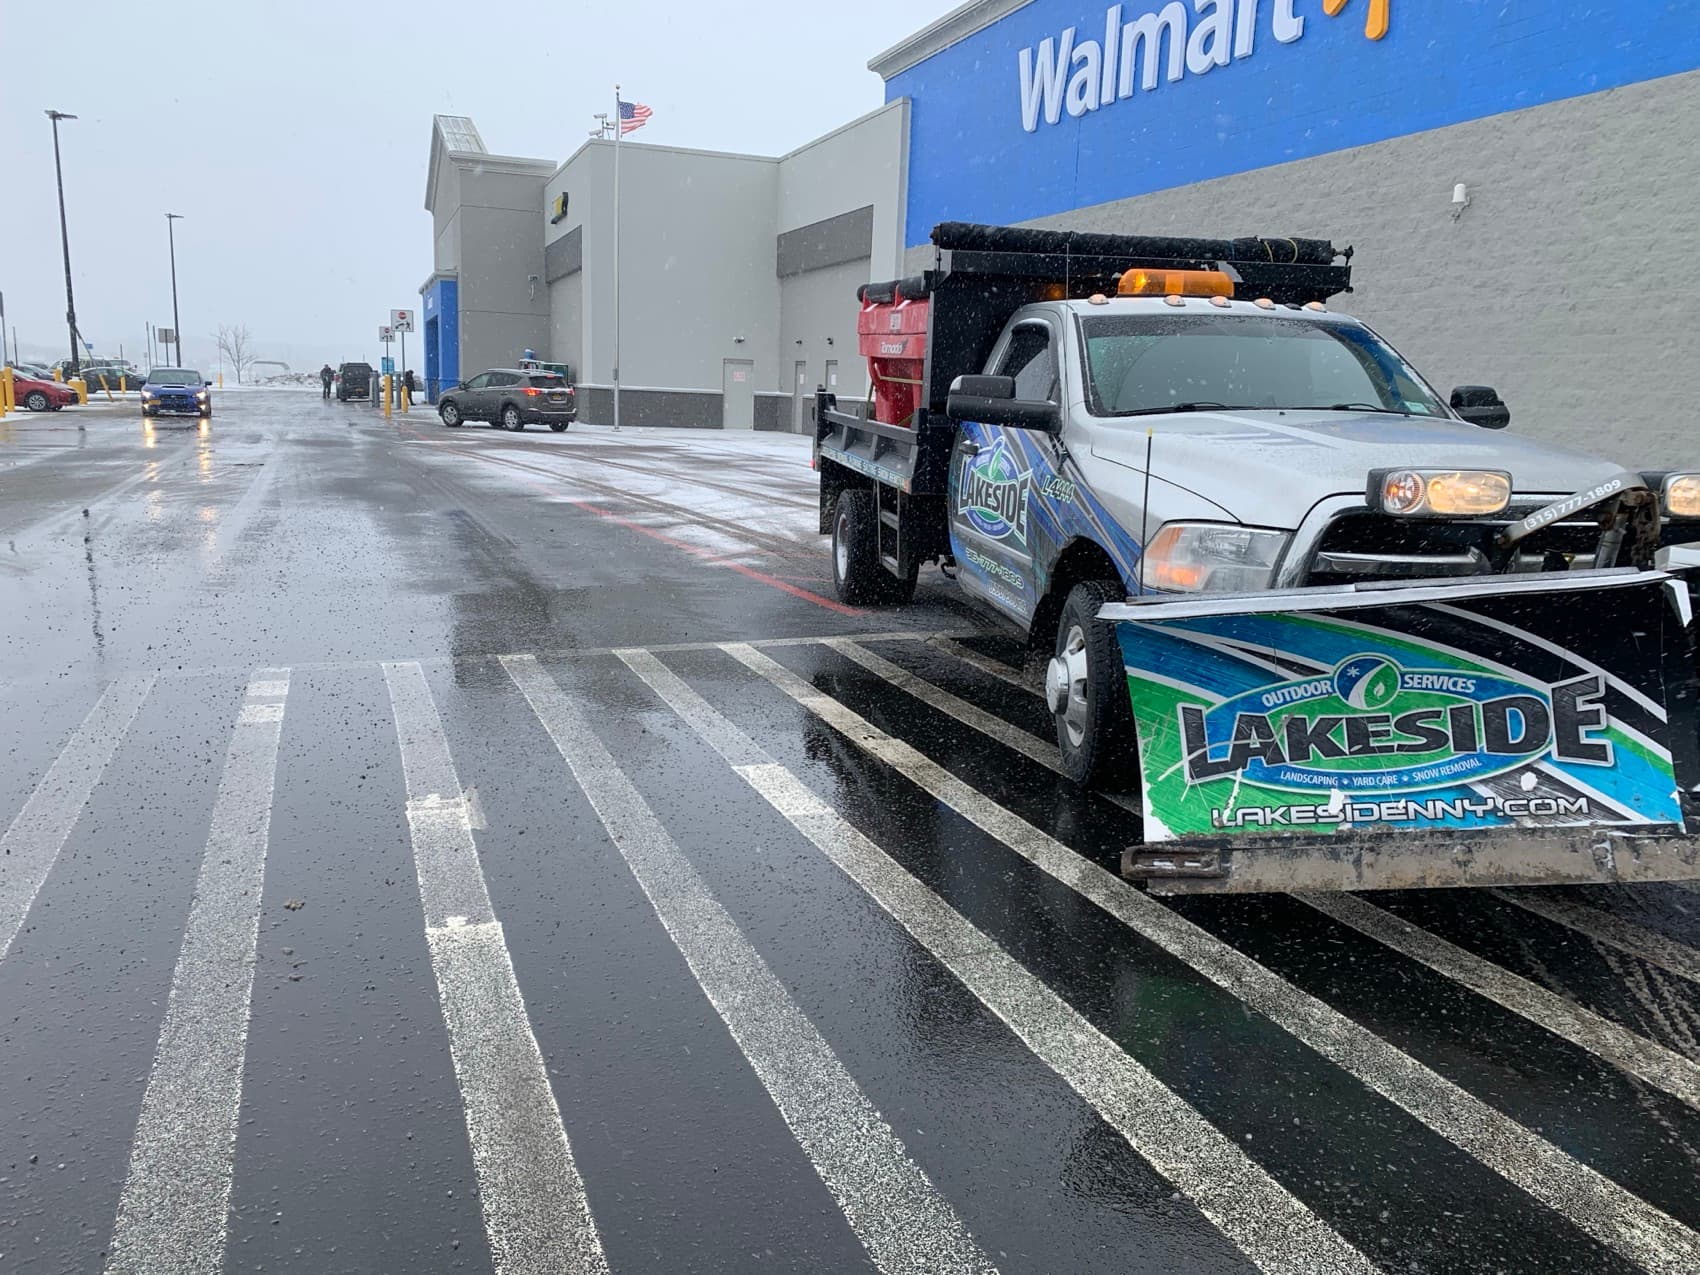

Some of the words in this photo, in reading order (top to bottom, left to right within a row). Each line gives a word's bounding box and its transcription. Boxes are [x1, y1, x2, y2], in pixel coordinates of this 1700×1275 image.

[959, 454, 1033, 546] LAKESIDE
[1523, 508, 1558, 531] (315)
[1558, 479, 1622, 514] 777-1809
[1261, 679, 1333, 708] OUTDOOR
[1403, 674, 1477, 693] SERVICES
[1177, 672, 1614, 785] LAKESIDE
[1280, 771, 1339, 786] LANDSCAPING
[1352, 776, 1375, 787] YARD
[1376, 774, 1399, 786] CARE
[1412, 769, 1441, 782] SNOW
[1441, 758, 1482, 776] REMOVAL
[1211, 797, 1590, 828] LAKESIDENNY.COM
